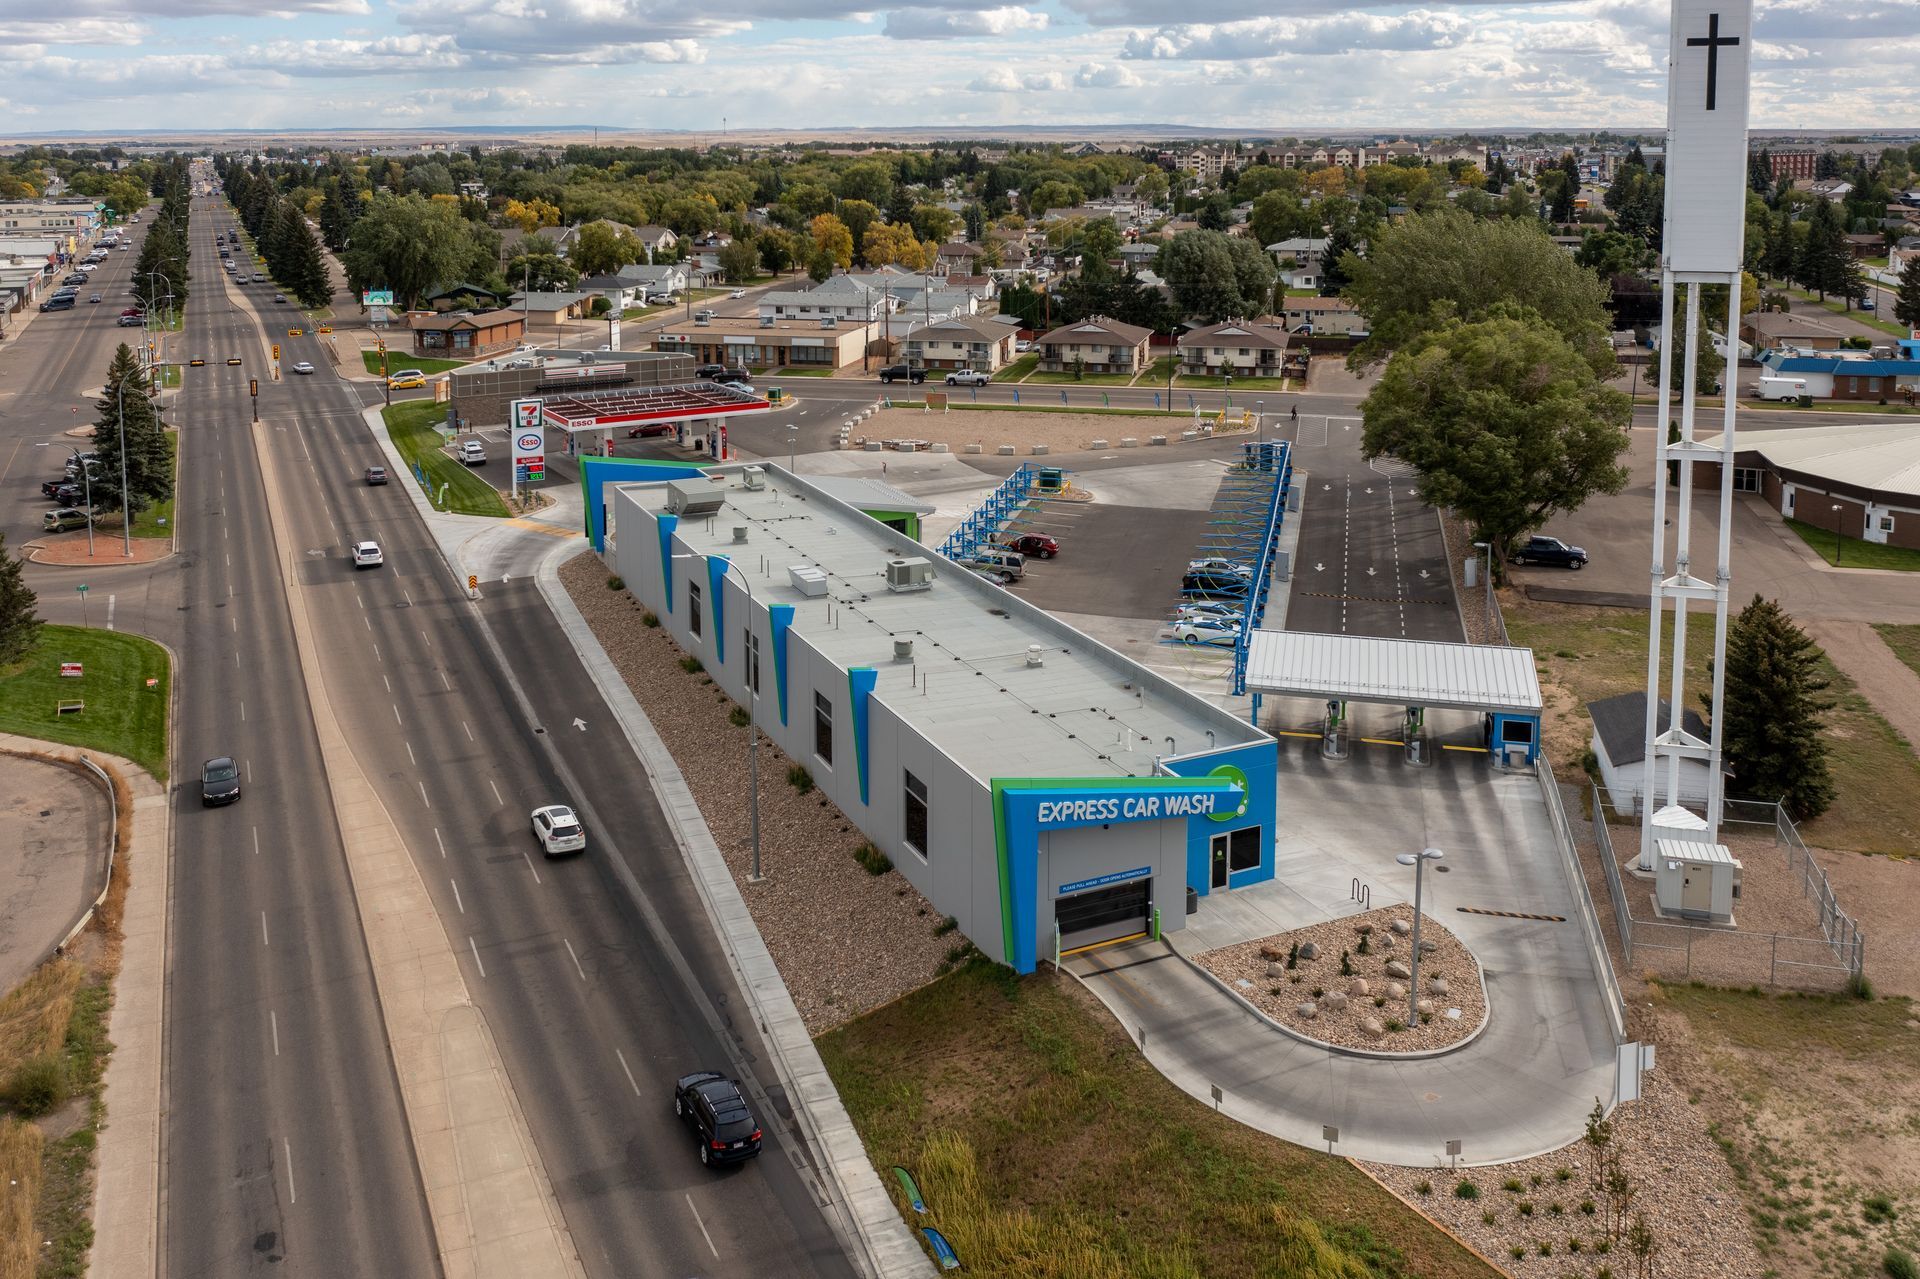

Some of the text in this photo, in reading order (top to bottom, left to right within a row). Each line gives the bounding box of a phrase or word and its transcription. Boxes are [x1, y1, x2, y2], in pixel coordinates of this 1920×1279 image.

[522, 406, 537, 415] 7
[1038, 794, 1215, 823] EXPRESS CAR WASH
